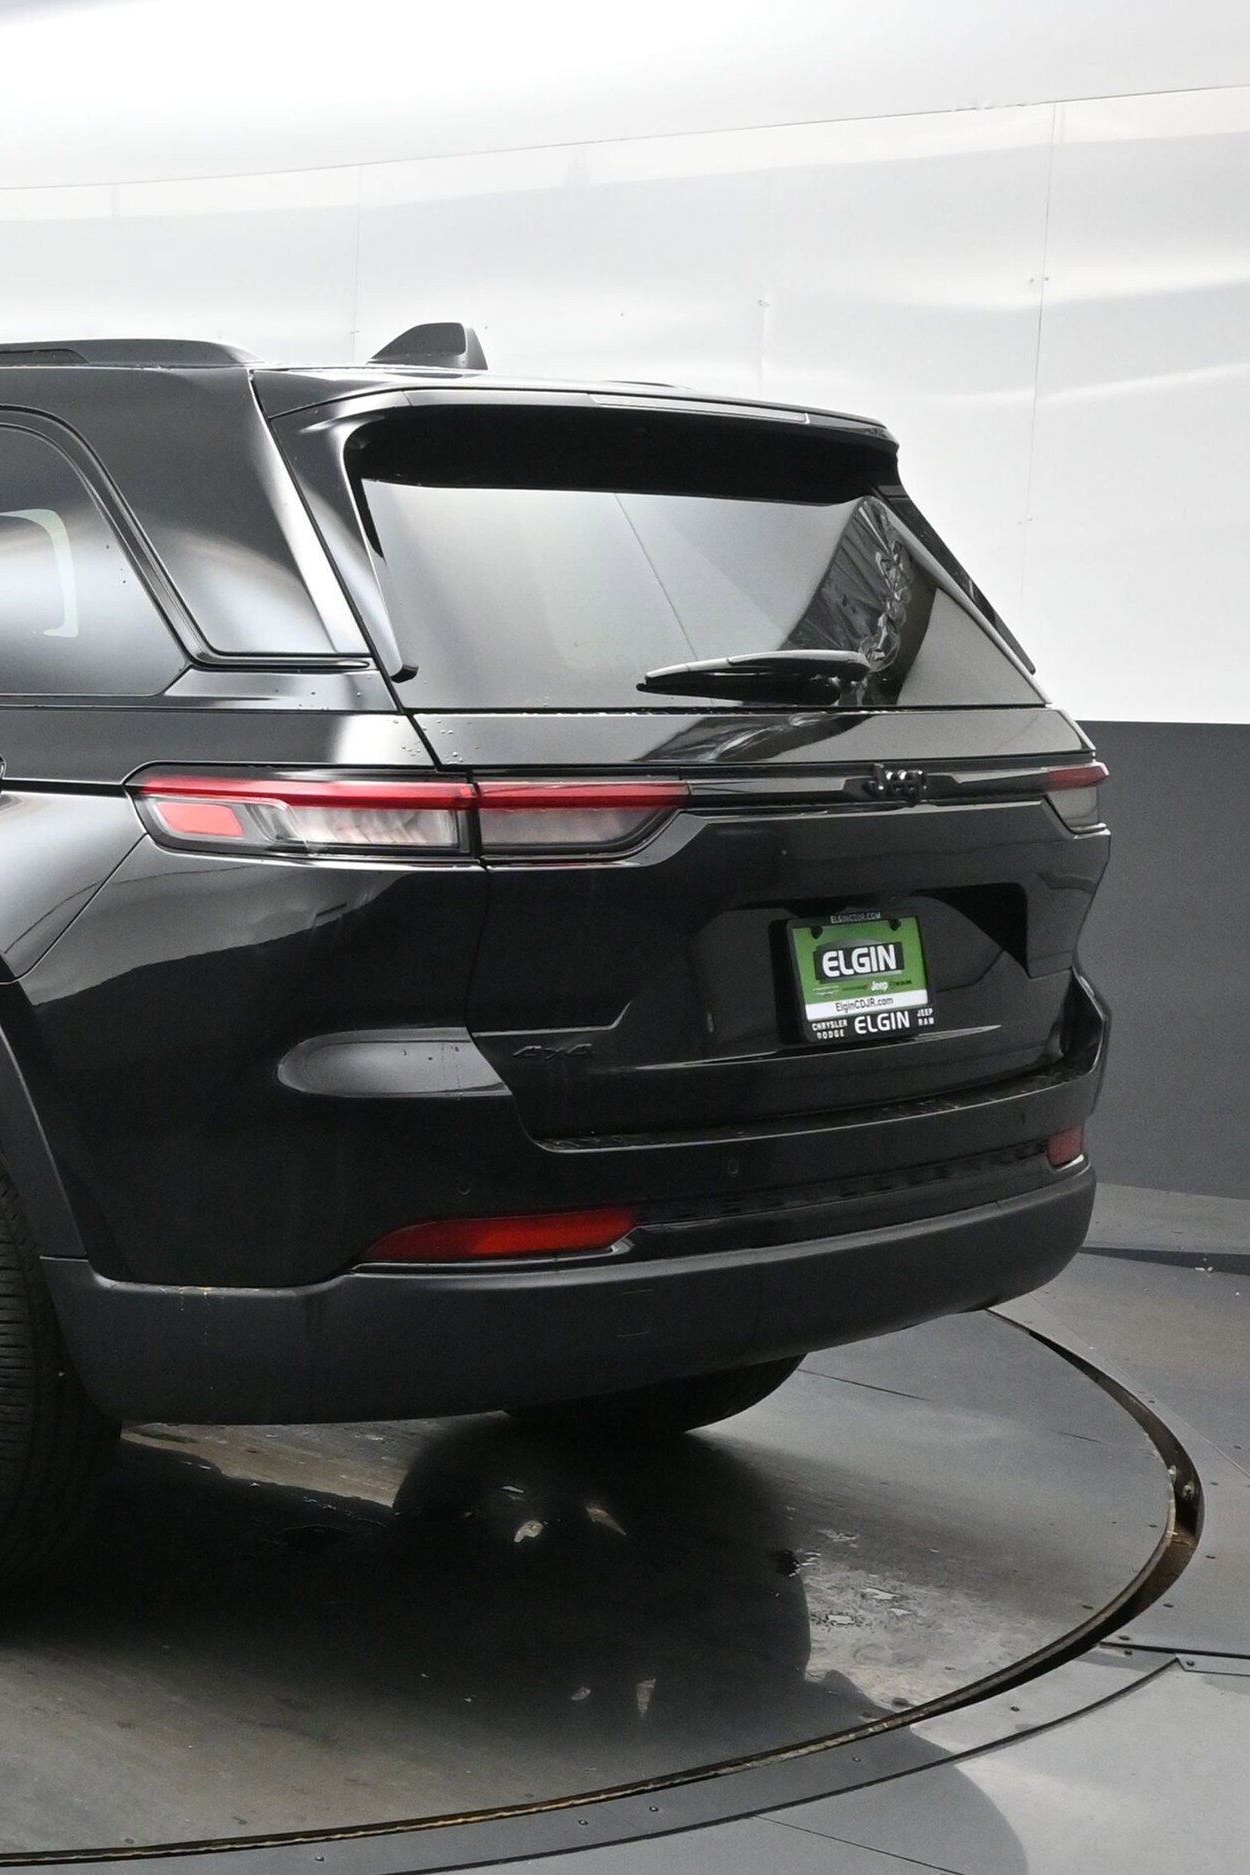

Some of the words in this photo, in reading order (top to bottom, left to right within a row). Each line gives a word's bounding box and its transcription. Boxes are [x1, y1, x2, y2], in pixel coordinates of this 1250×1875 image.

[822, 944, 897, 978] ELGIN
[870, 980, 889, 992] Jeep
[835, 996, 894, 1013] ElginCDJR.com
[916, 1007, 934, 1018] JEEP
[811, 1019, 848, 1031] CHRYSLER
[854, 1011, 911, 1035] ELGIN
[918, 1017, 935, 1026] RAM
[817, 1029, 845, 1040] DODGE
